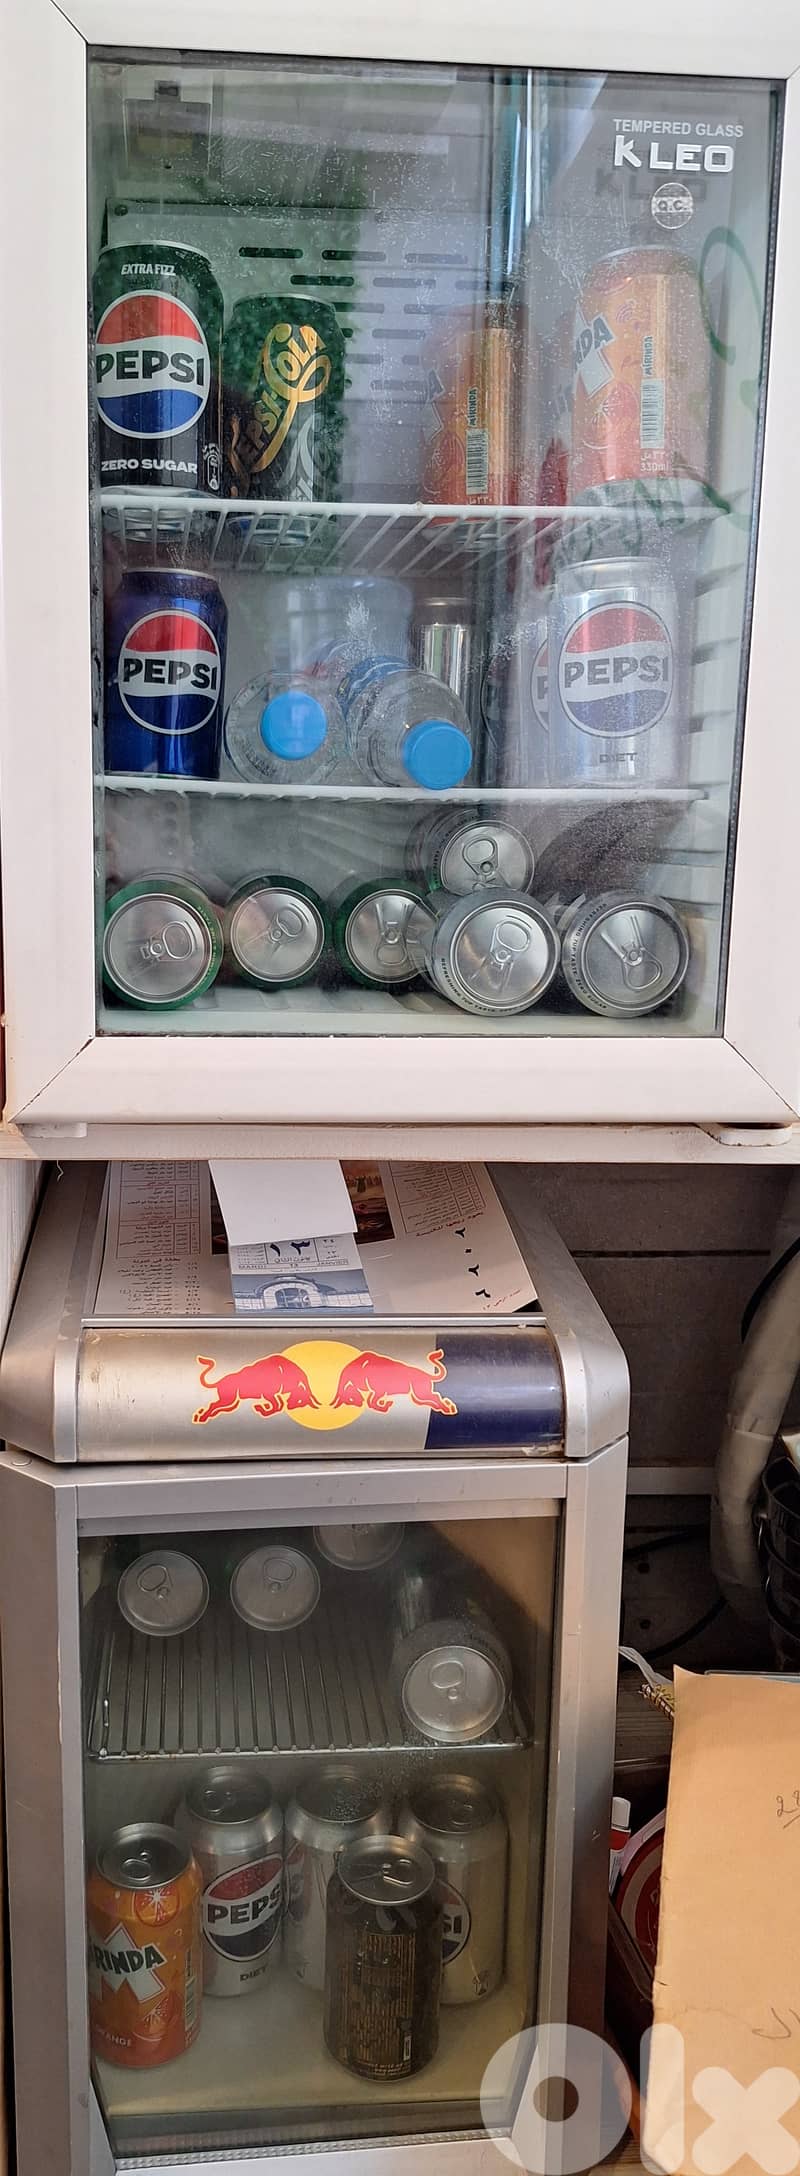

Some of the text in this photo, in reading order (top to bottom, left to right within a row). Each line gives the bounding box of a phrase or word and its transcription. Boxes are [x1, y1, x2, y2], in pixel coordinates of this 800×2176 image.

[613, 118, 744, 138] TEMPERED GLASS
[121, 263, 177, 277] EXTRA FIZZ
[96, 350, 205, 386] PEPSI
[642, 336, 653, 376] MIRINDA
[467, 388, 477, 426] MIRINDA
[101, 458, 198, 475] ZERO SUGAR
[123, 657, 217, 690] PEPSI
[564, 656, 669, 688] PEPSI
[600, 752, 638, 764] DIET
[207, 1883, 282, 1925] PEPS
[92, 1943, 165, 1975] RINDA
[239, 1966, 268, 1982] DIET
